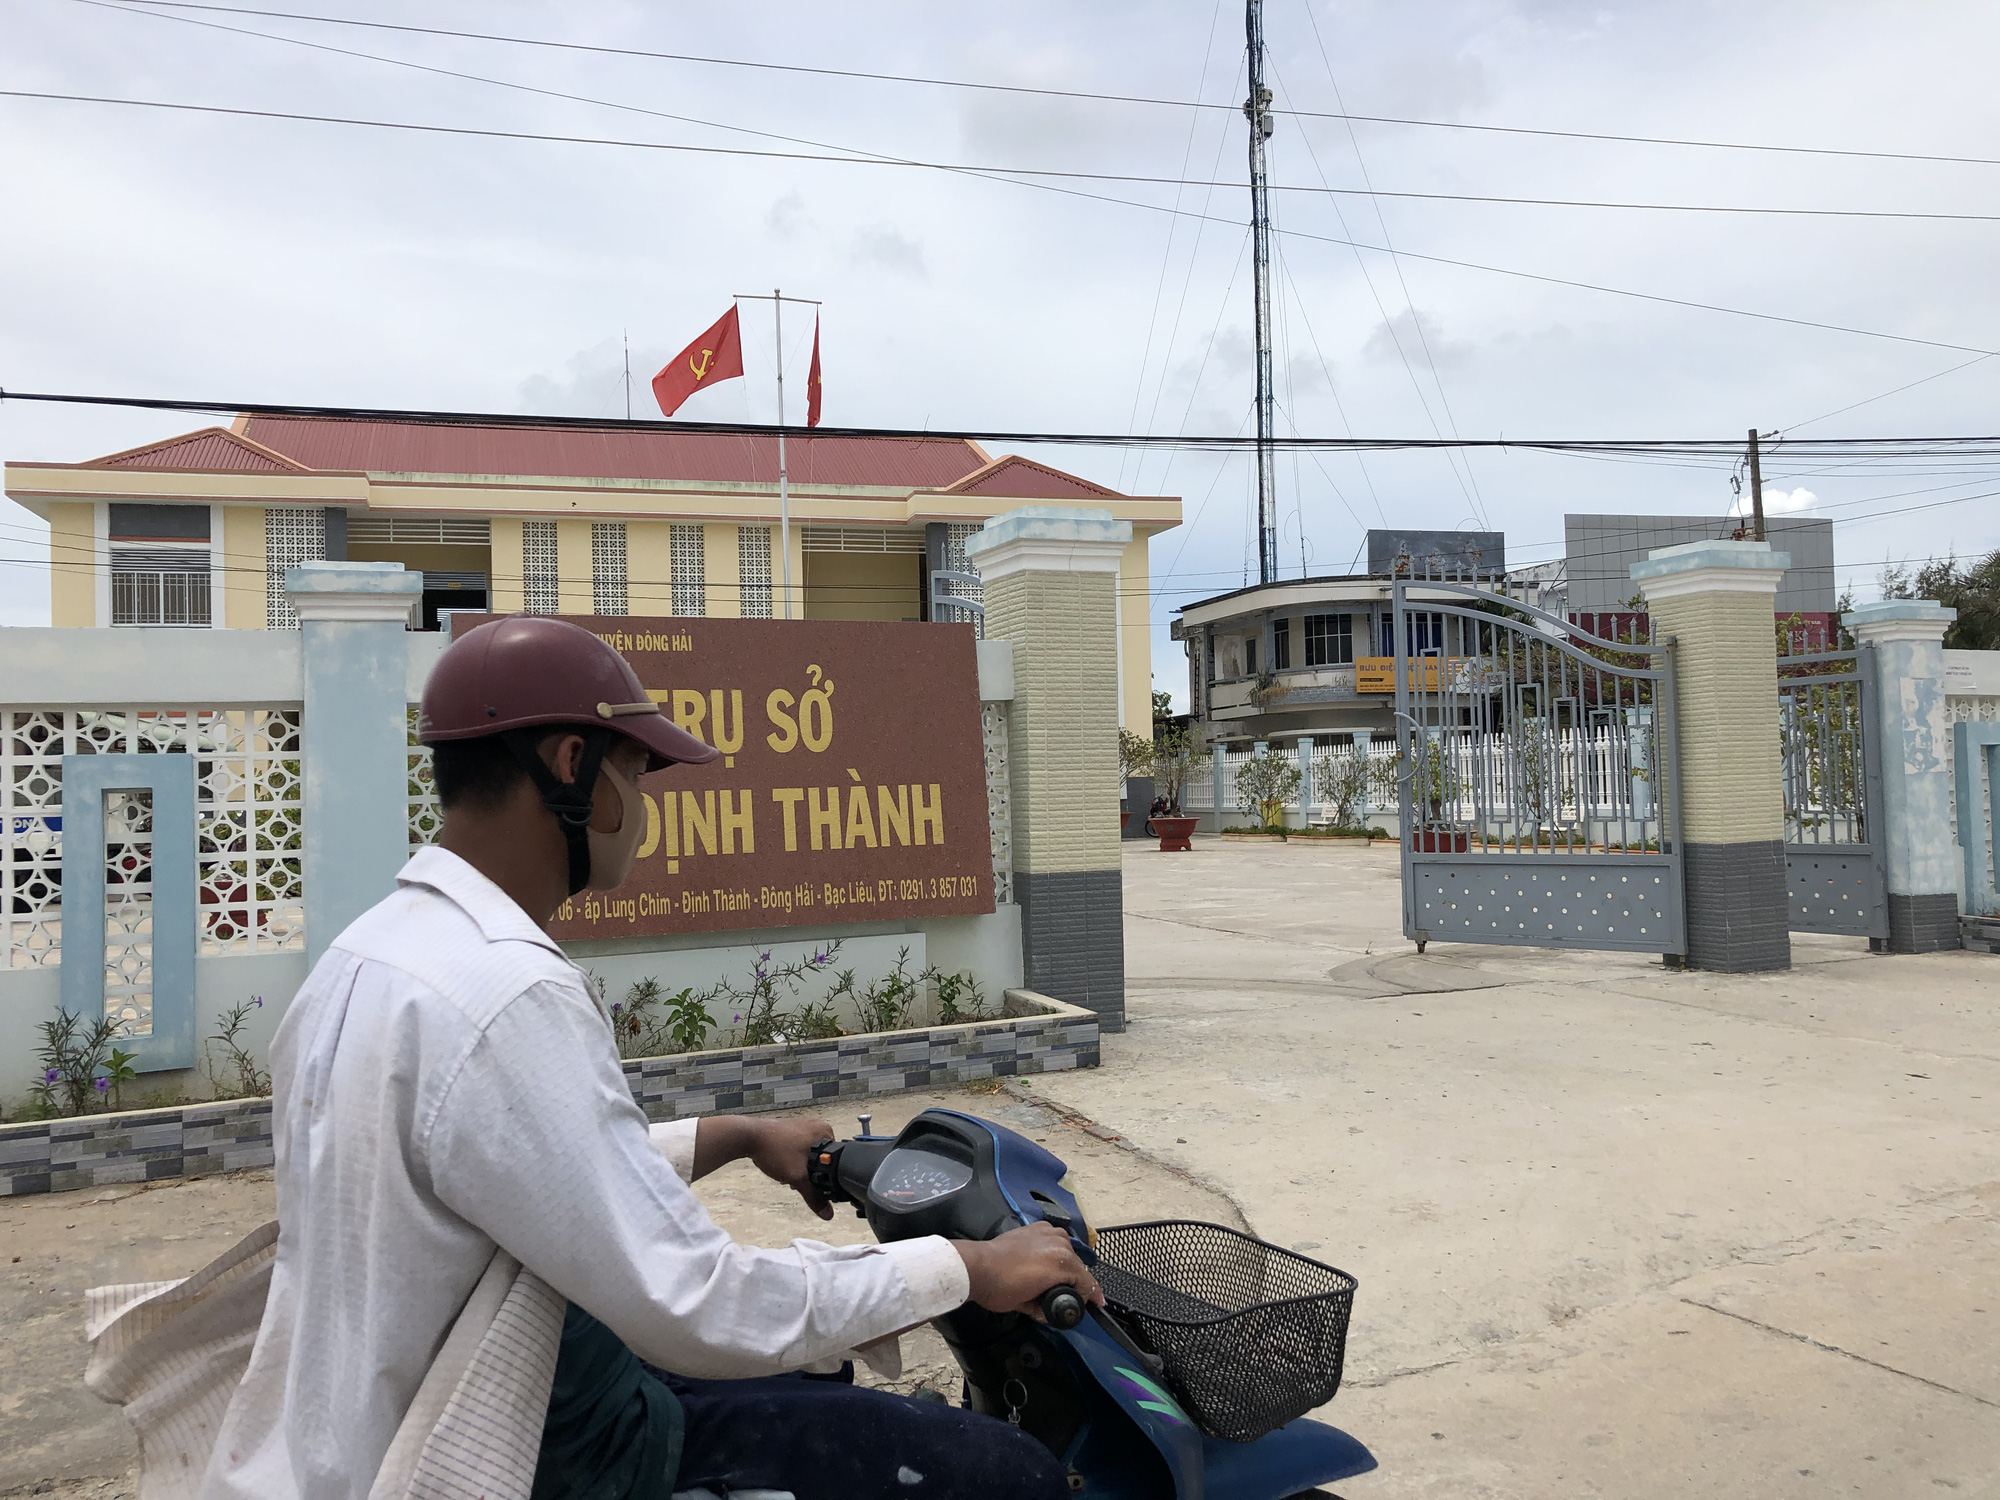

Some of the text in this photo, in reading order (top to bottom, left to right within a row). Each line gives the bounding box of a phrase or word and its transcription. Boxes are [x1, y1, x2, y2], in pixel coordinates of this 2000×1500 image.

[636, 629, 669, 652] ĐÔNG
[672, 628, 693, 652] HẢI
[766, 664, 835, 754] SỞ
[772, 768, 945, 852] THÀNH
[584, 892, 601, 925] ấp
[604, 895, 635, 923] Lung
[639, 892, 671, 917] Chim
[682, 890, 710, 918] Định
[713, 887, 751, 912] Thành
[761, 885, 792, 913] Đông
[795, 881, 814, 907] Hải
[824, 882, 846, 909] Bạc
[849, 881, 876, 906] Liêu,
[878, 879, 898, 902] ĐT:
[900, 878, 928, 901] 0291.
[930, 877, 937, 899] 3
[939, 876, 958, 898] 857
[960, 875, 978, 898] 031
